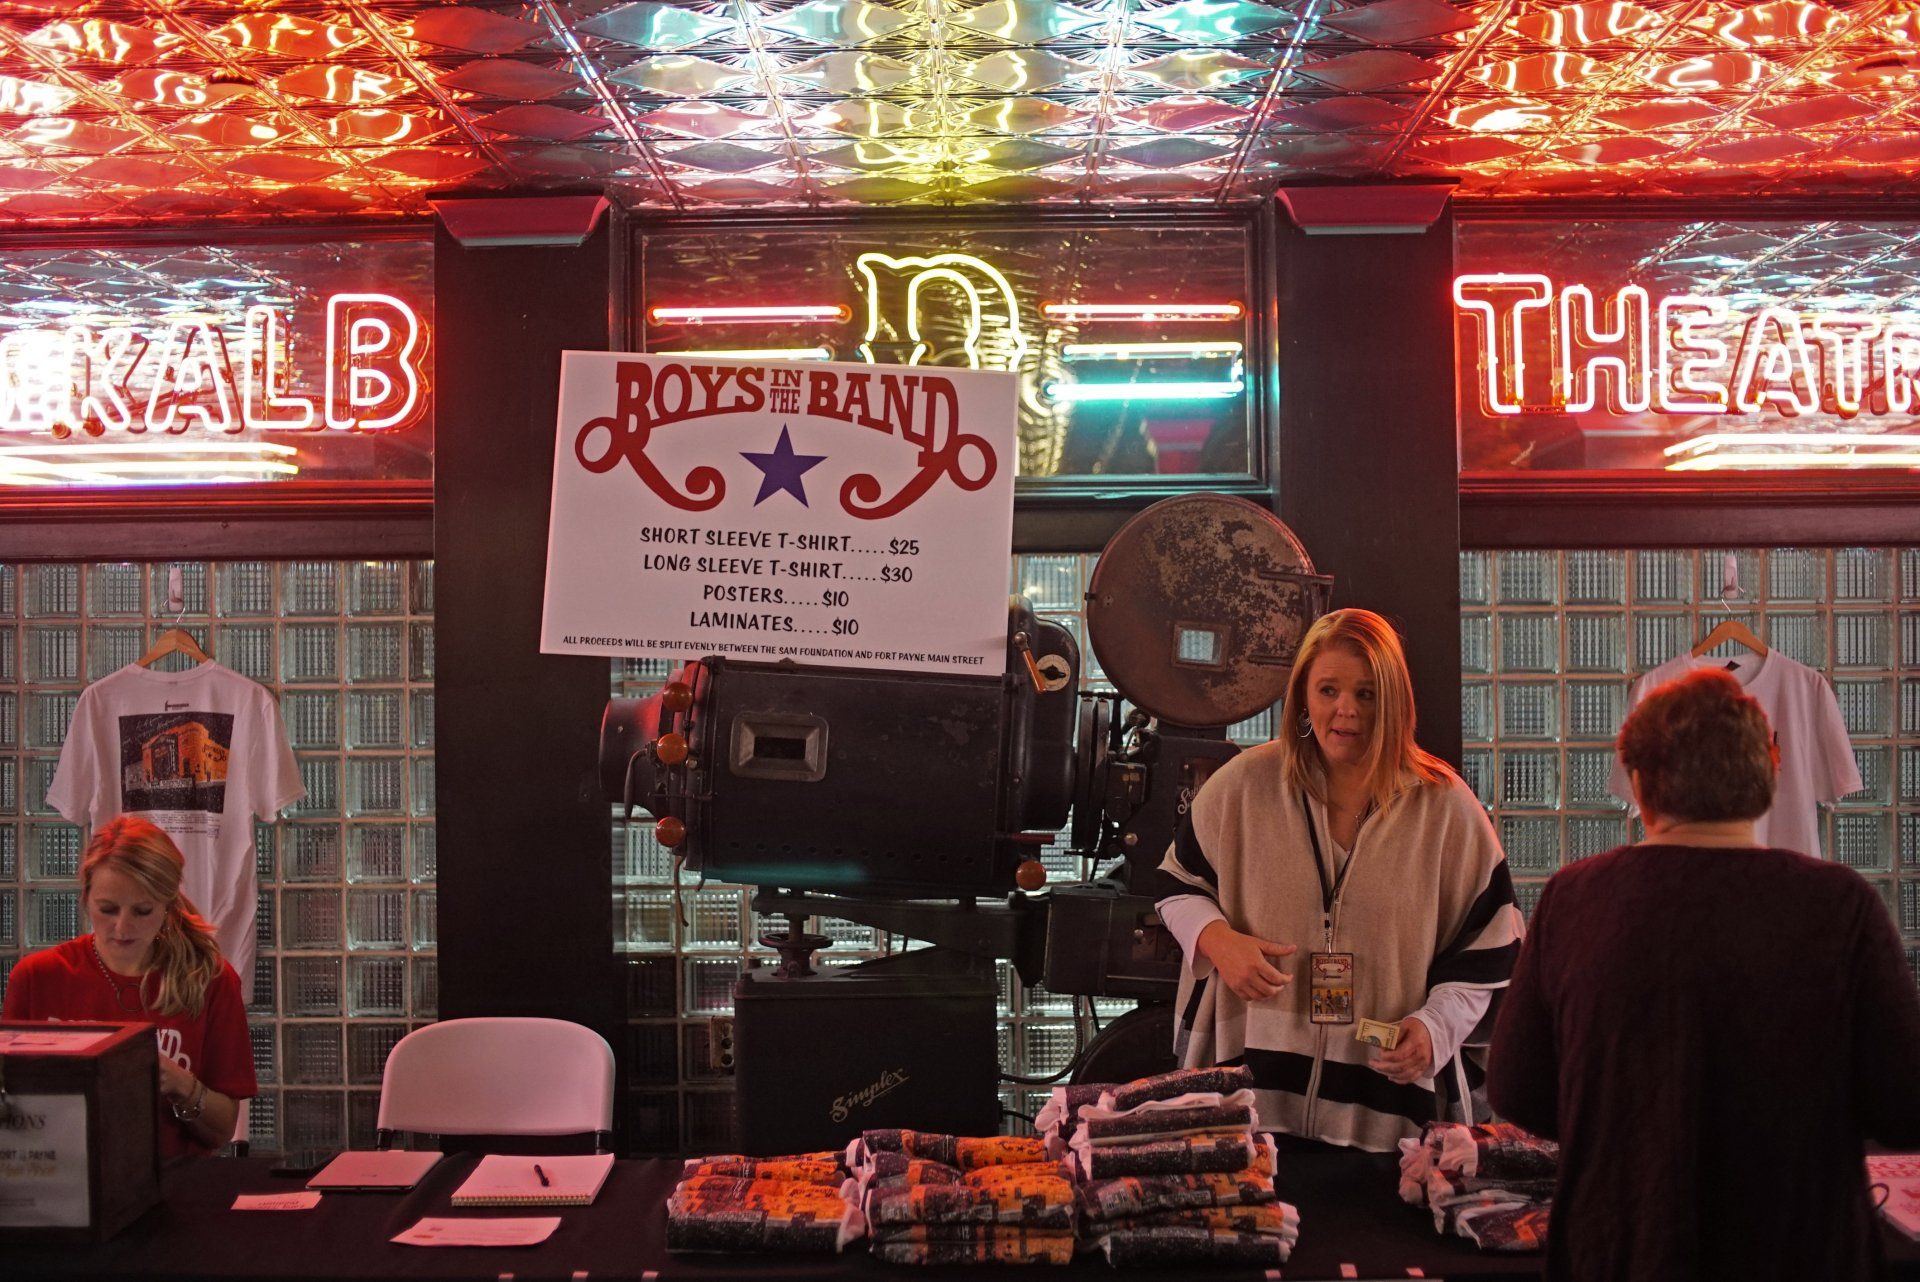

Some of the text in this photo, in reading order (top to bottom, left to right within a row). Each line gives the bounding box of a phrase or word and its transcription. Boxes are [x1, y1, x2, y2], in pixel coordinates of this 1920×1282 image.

[615, 361, 959, 467] BOYS IN THE BAND
[639, 526, 701, 545] SHORT
[705, 529, 772, 549] SLEEVE
[644, 553, 692, 573] LONG
[696, 556, 763, 576] SLEEVE
[563, 635, 985, 666] ALL PROCEEDS WILL BE SPLIT EVENLY BETWEEN THE SAM FOUNDATION AND FORT PAYNE MAIN STREET
[830, 1068, 909, 1122] Simplex
